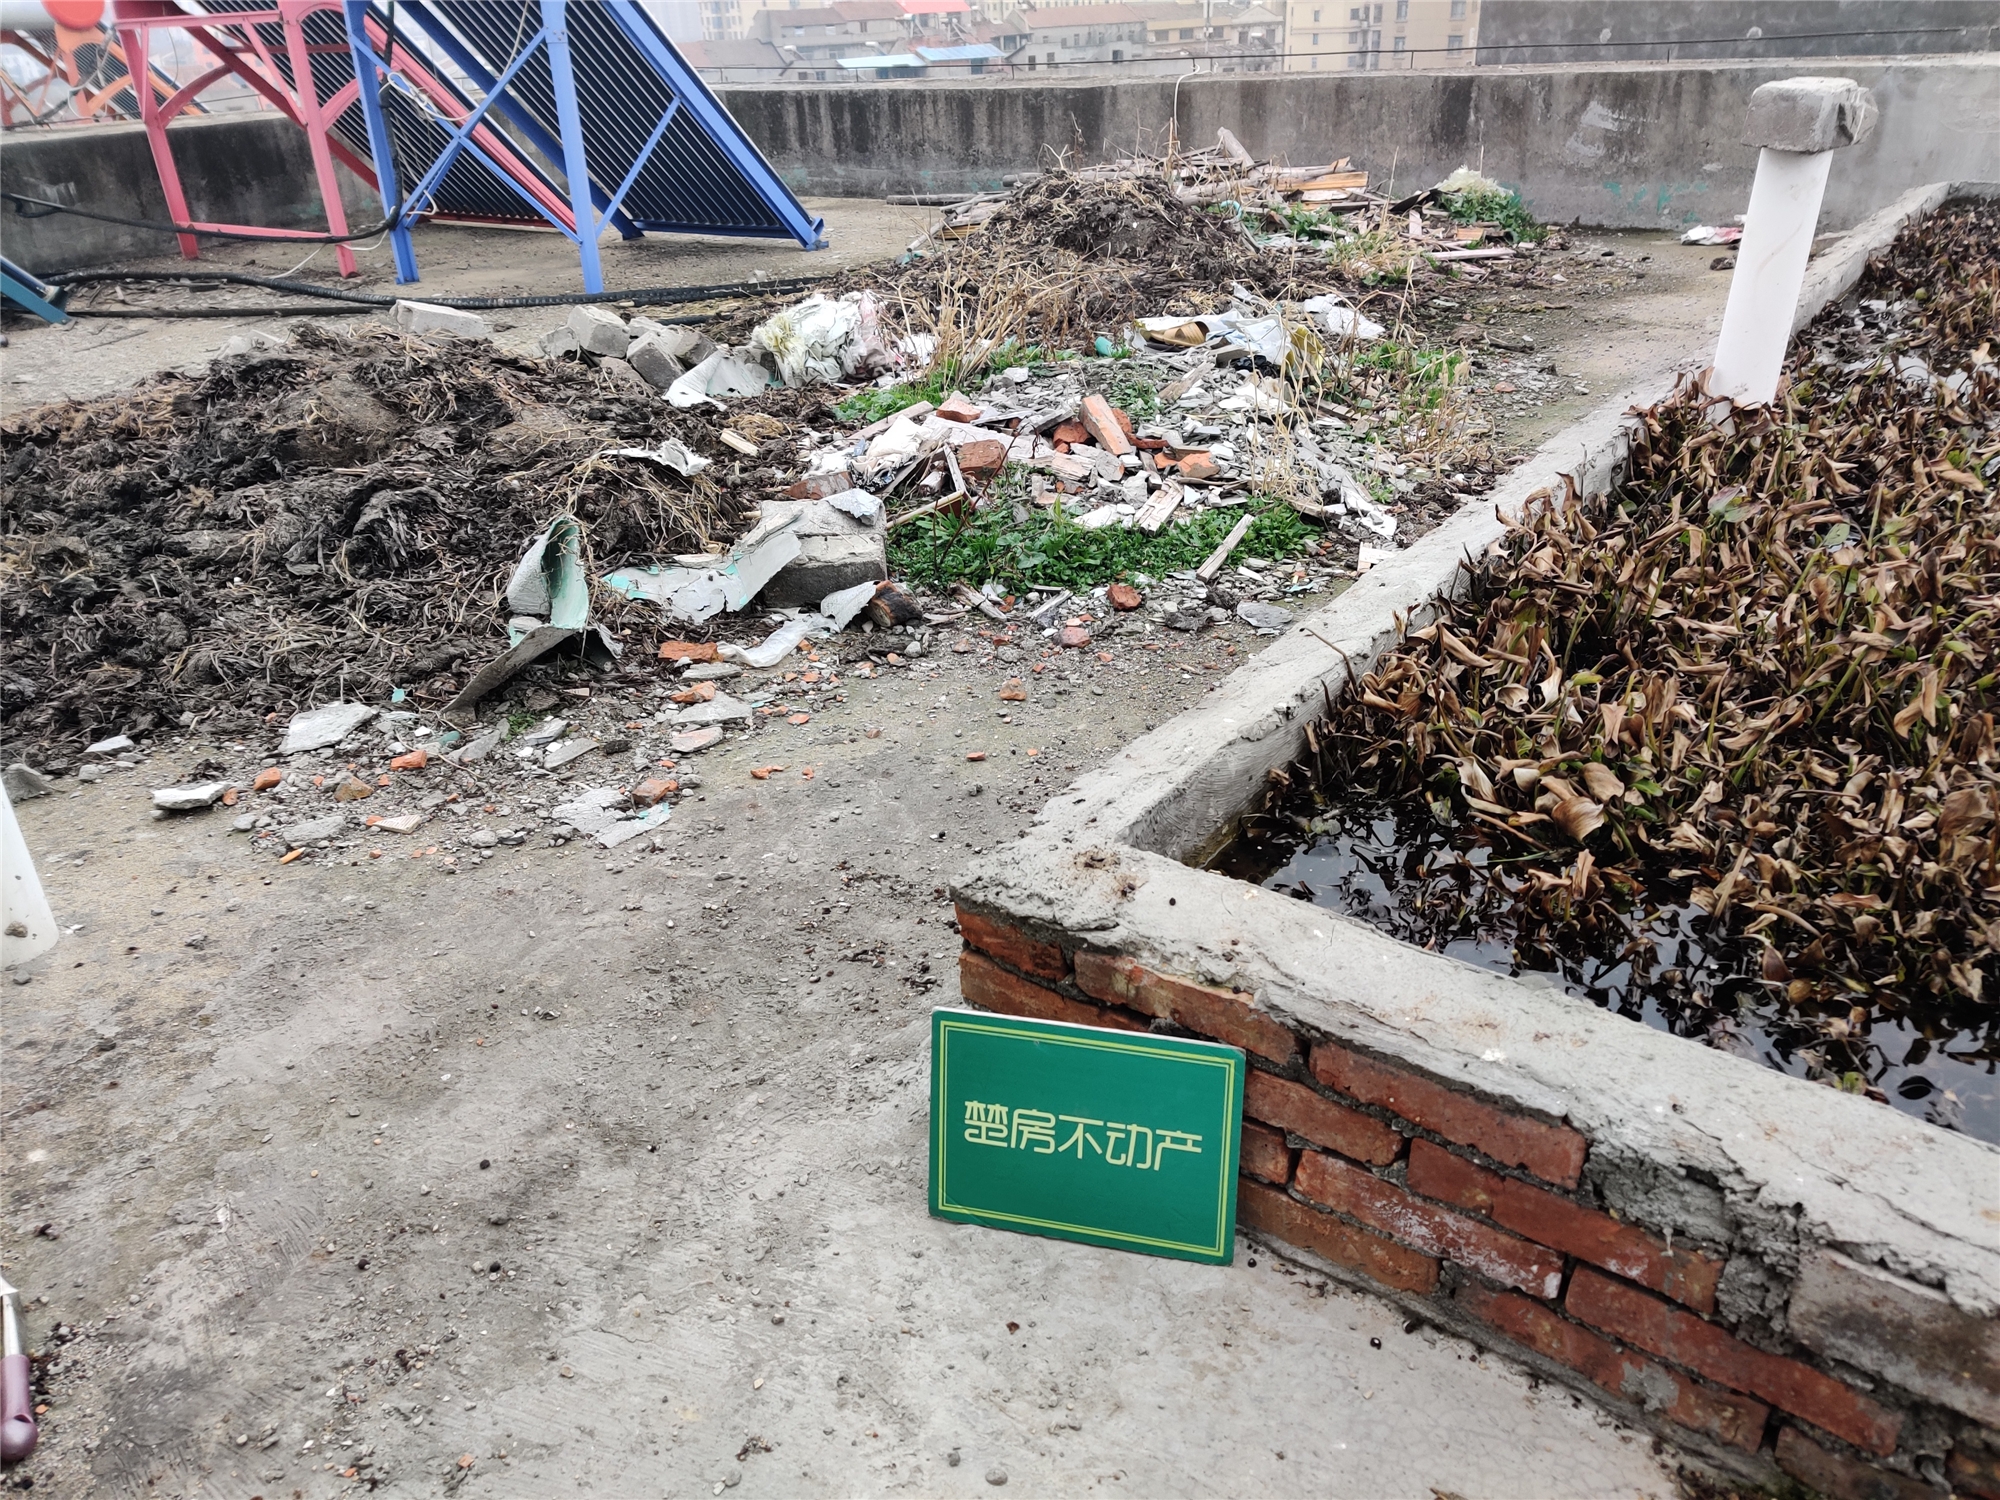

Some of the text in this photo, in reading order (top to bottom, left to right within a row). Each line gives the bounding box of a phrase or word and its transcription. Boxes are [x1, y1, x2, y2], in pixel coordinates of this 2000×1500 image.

[964, 1100, 1202, 1171] 楚房不动产
